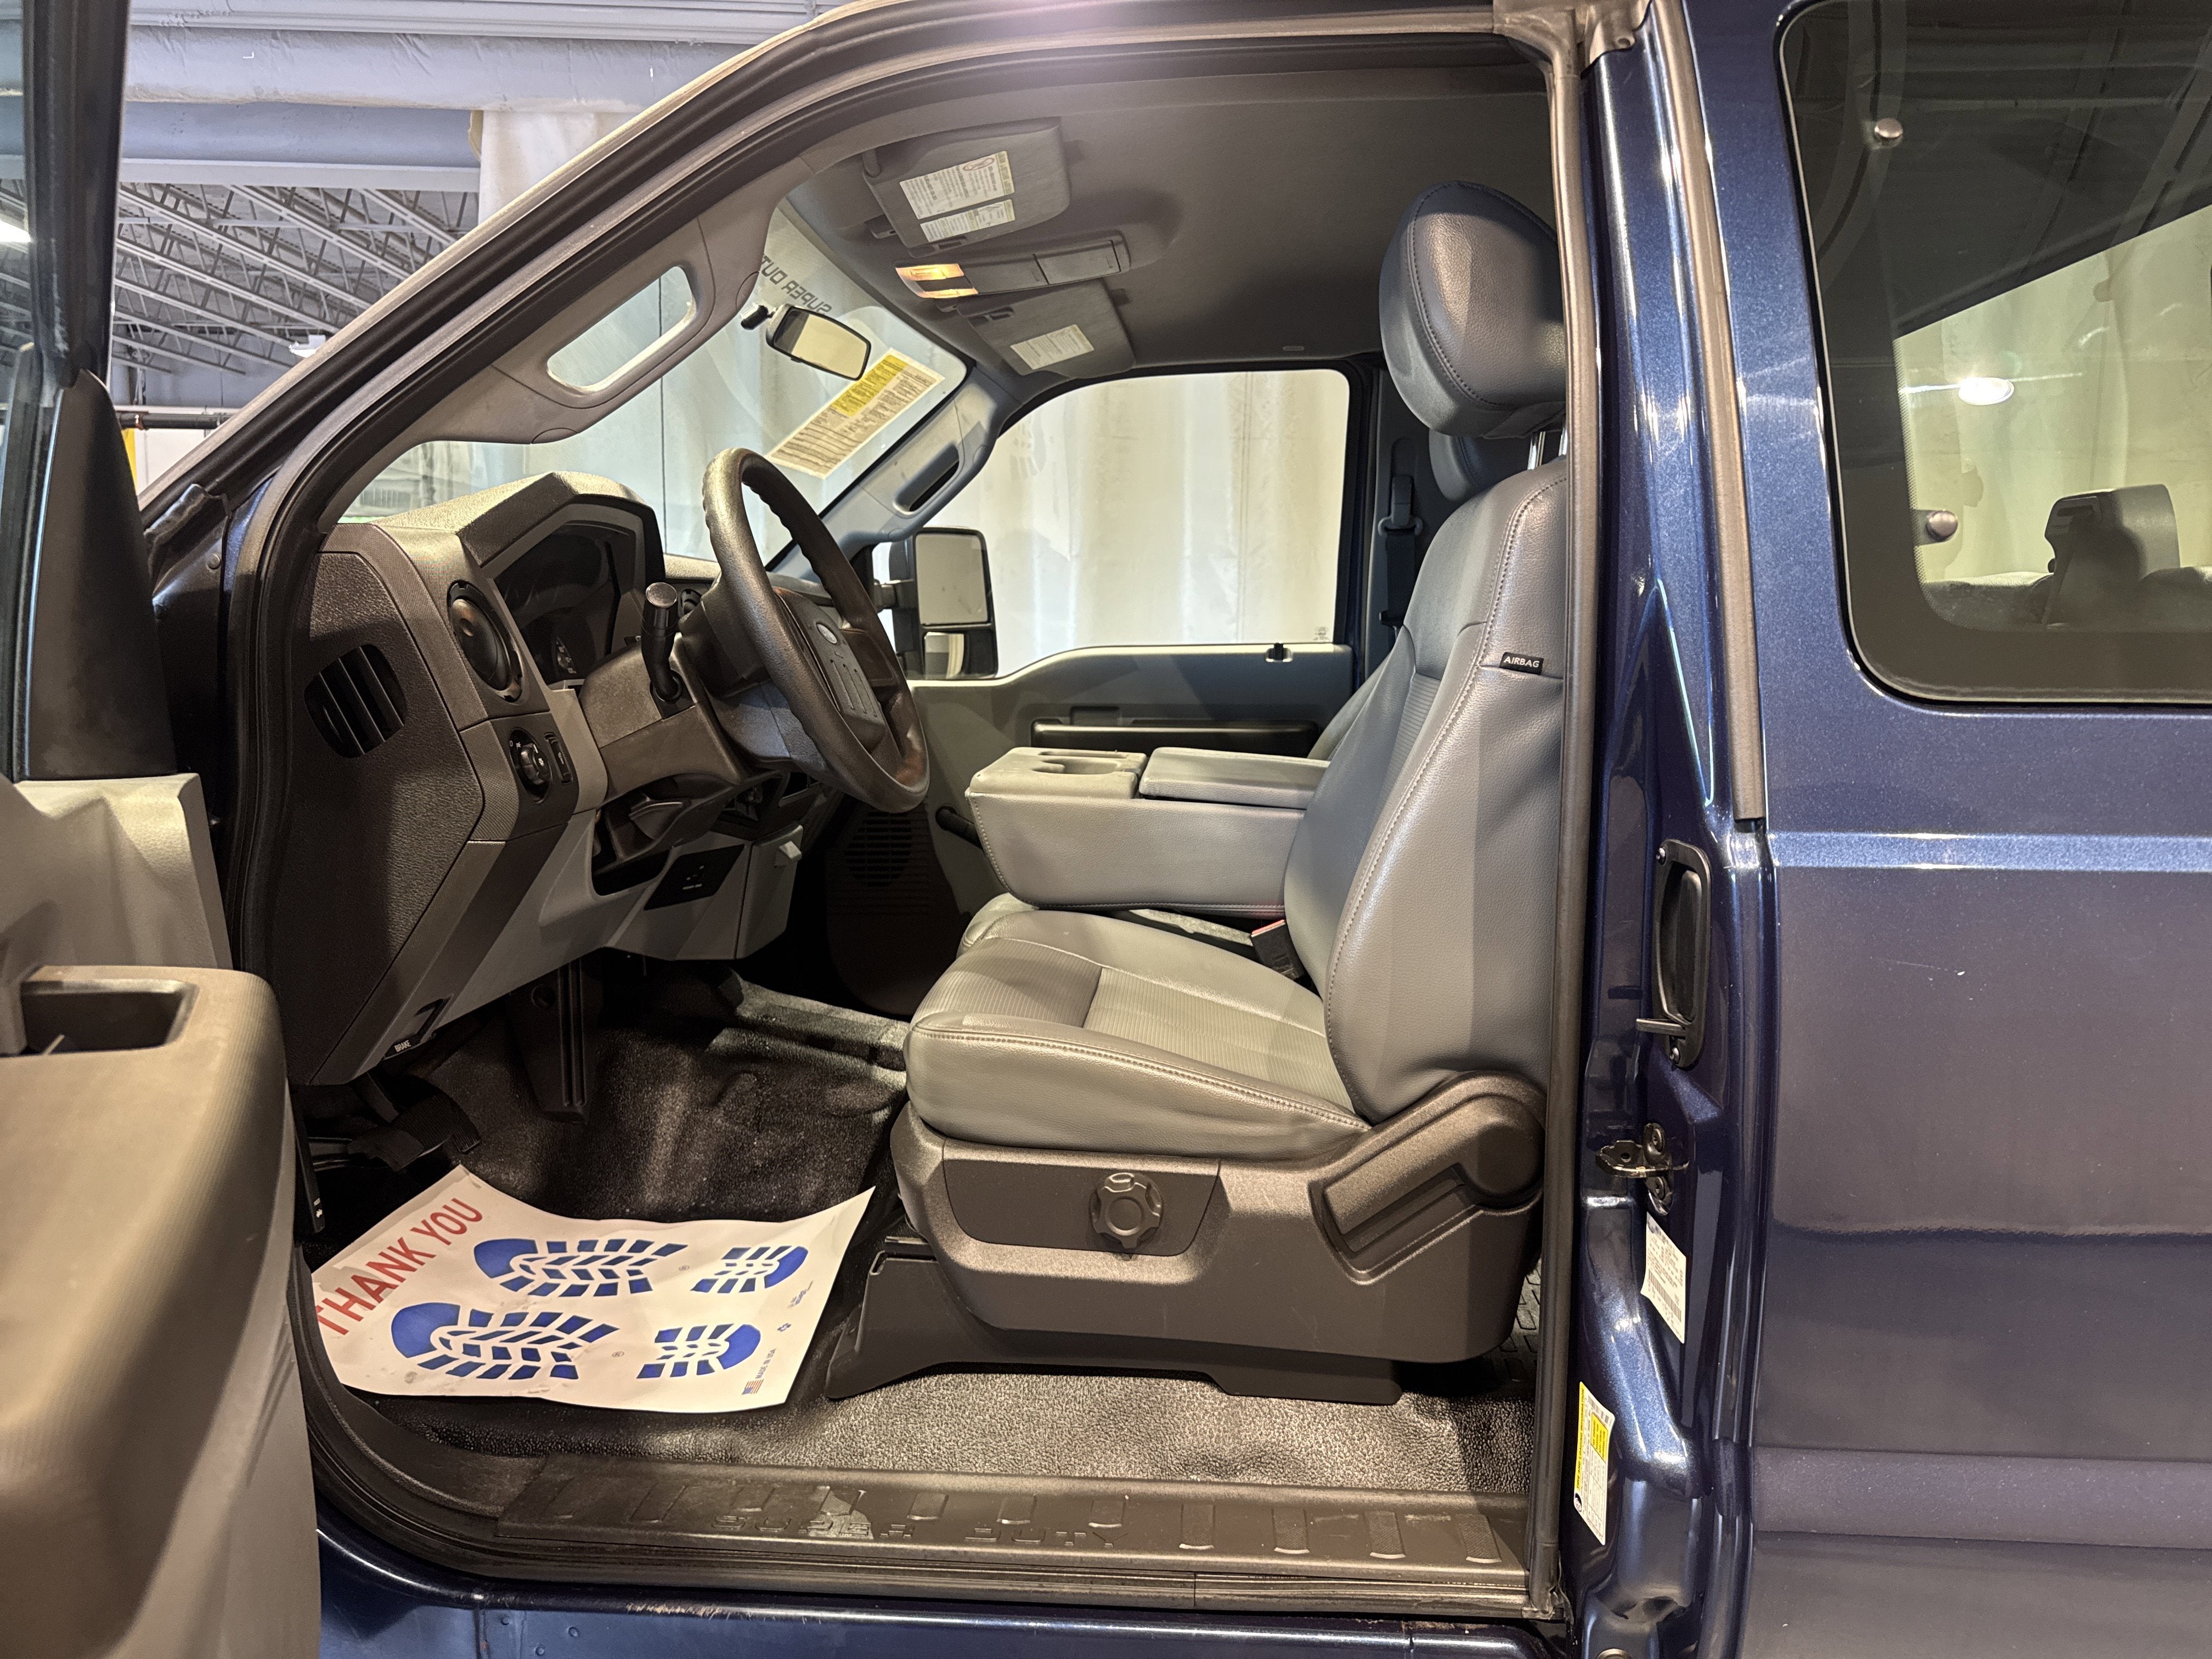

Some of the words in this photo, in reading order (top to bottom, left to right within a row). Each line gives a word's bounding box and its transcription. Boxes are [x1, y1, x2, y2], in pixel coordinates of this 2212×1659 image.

[1503, 656, 1540, 668] AIRBAG
[394, 1039, 412, 1052] BRAKE
[315, 1237, 437, 1335] THANK
[409, 1197, 483, 1246] YOU
[711, 1514, 916, 1537] SUPER
[963, 1527, 1129, 1548] DUTY
